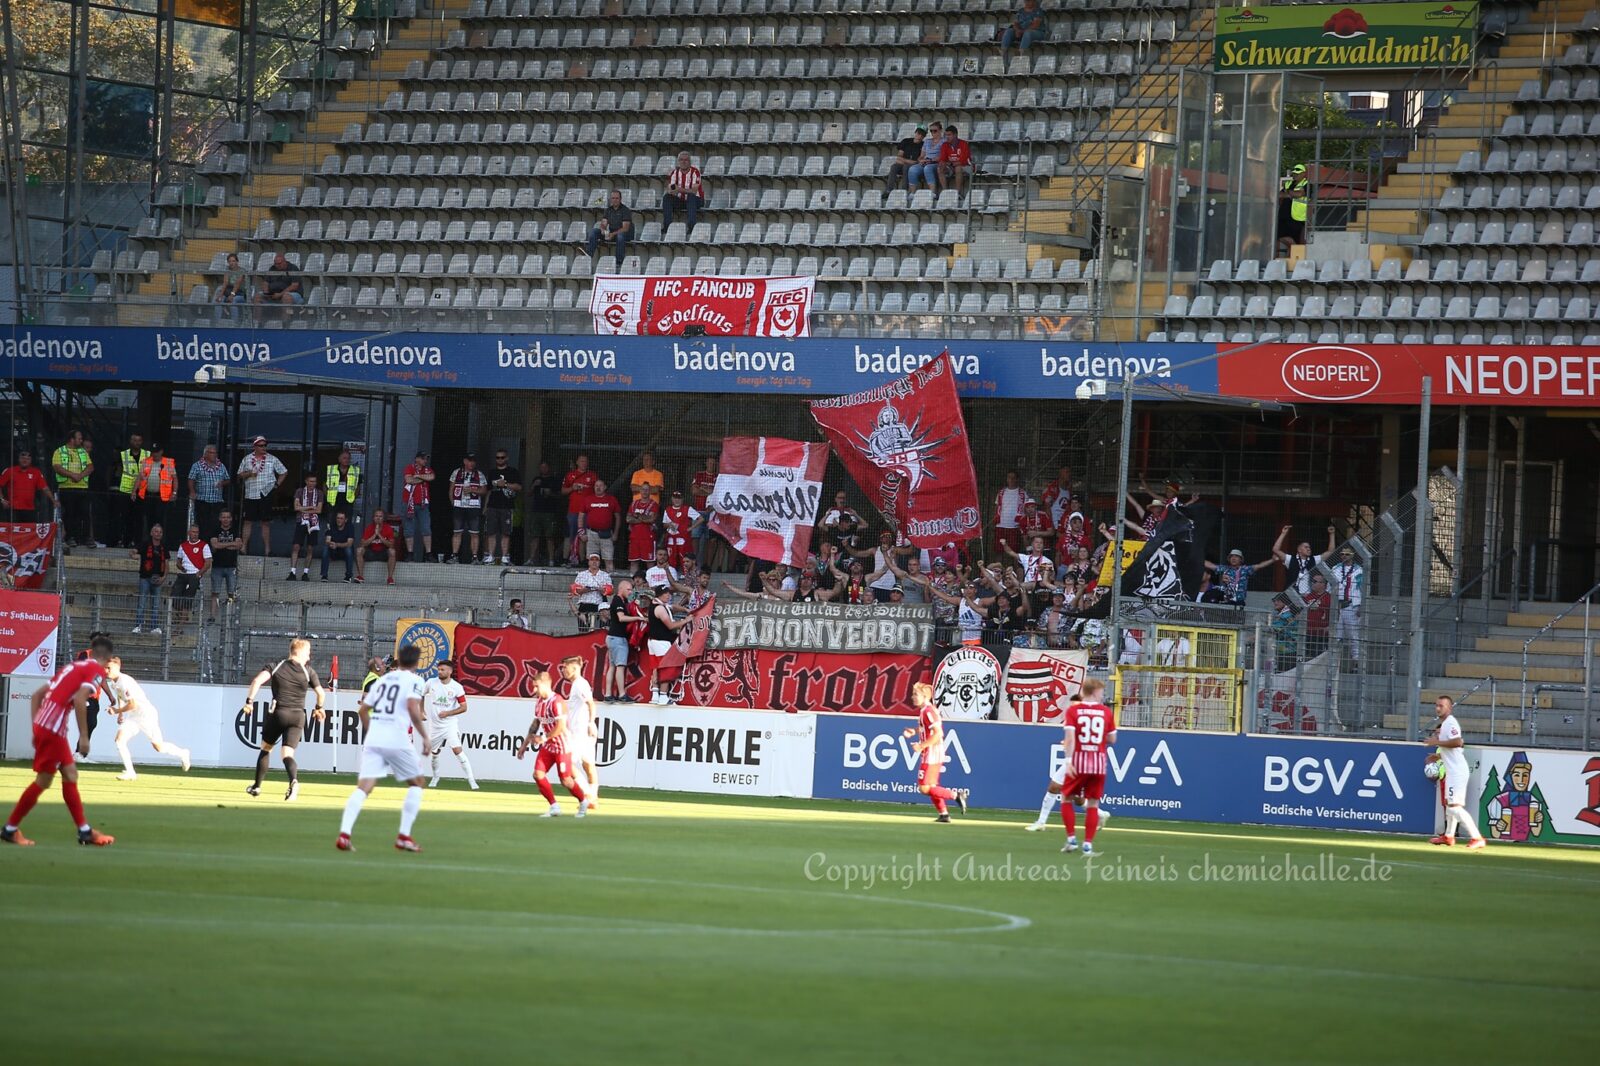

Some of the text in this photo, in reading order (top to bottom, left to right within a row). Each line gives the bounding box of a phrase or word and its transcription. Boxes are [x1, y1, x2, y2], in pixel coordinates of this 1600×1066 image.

[1220, 35, 1470, 66] Schwarzwaldmilch
[606, 292, 629, 302] HFC
[654, 281, 679, 298] HFC
[692, 280, 755, 299] FANCLUB
[771, 290, 804, 304] HFC
[156, 334, 271, 361] badenova
[326, 337, 441, 365] badenova
[498, 341, 616, 369] badenova
[673, 343, 796, 371] badenova
[854, 345, 980, 375] badenva
[1041, 348, 1172, 378] badenova
[1293, 365, 1369, 382] NEOPERL
[706, 615, 936, 651] STADIONVERBOT
[946, 650, 995, 668] Ultras
[960, 675, 976, 683] HFC
[372, 683, 400, 715] 29
[1077, 715, 1105, 744] 39
[637, 724, 762, 766] MERKLE
[712, 772, 760, 786] BEWEGT
[842, 779, 888, 792] Badische
[1264, 755, 1355, 796] BGV
[1099, 793, 1182, 811] Versicherungen
[1263, 803, 1403, 824] Badische Versicherungen
